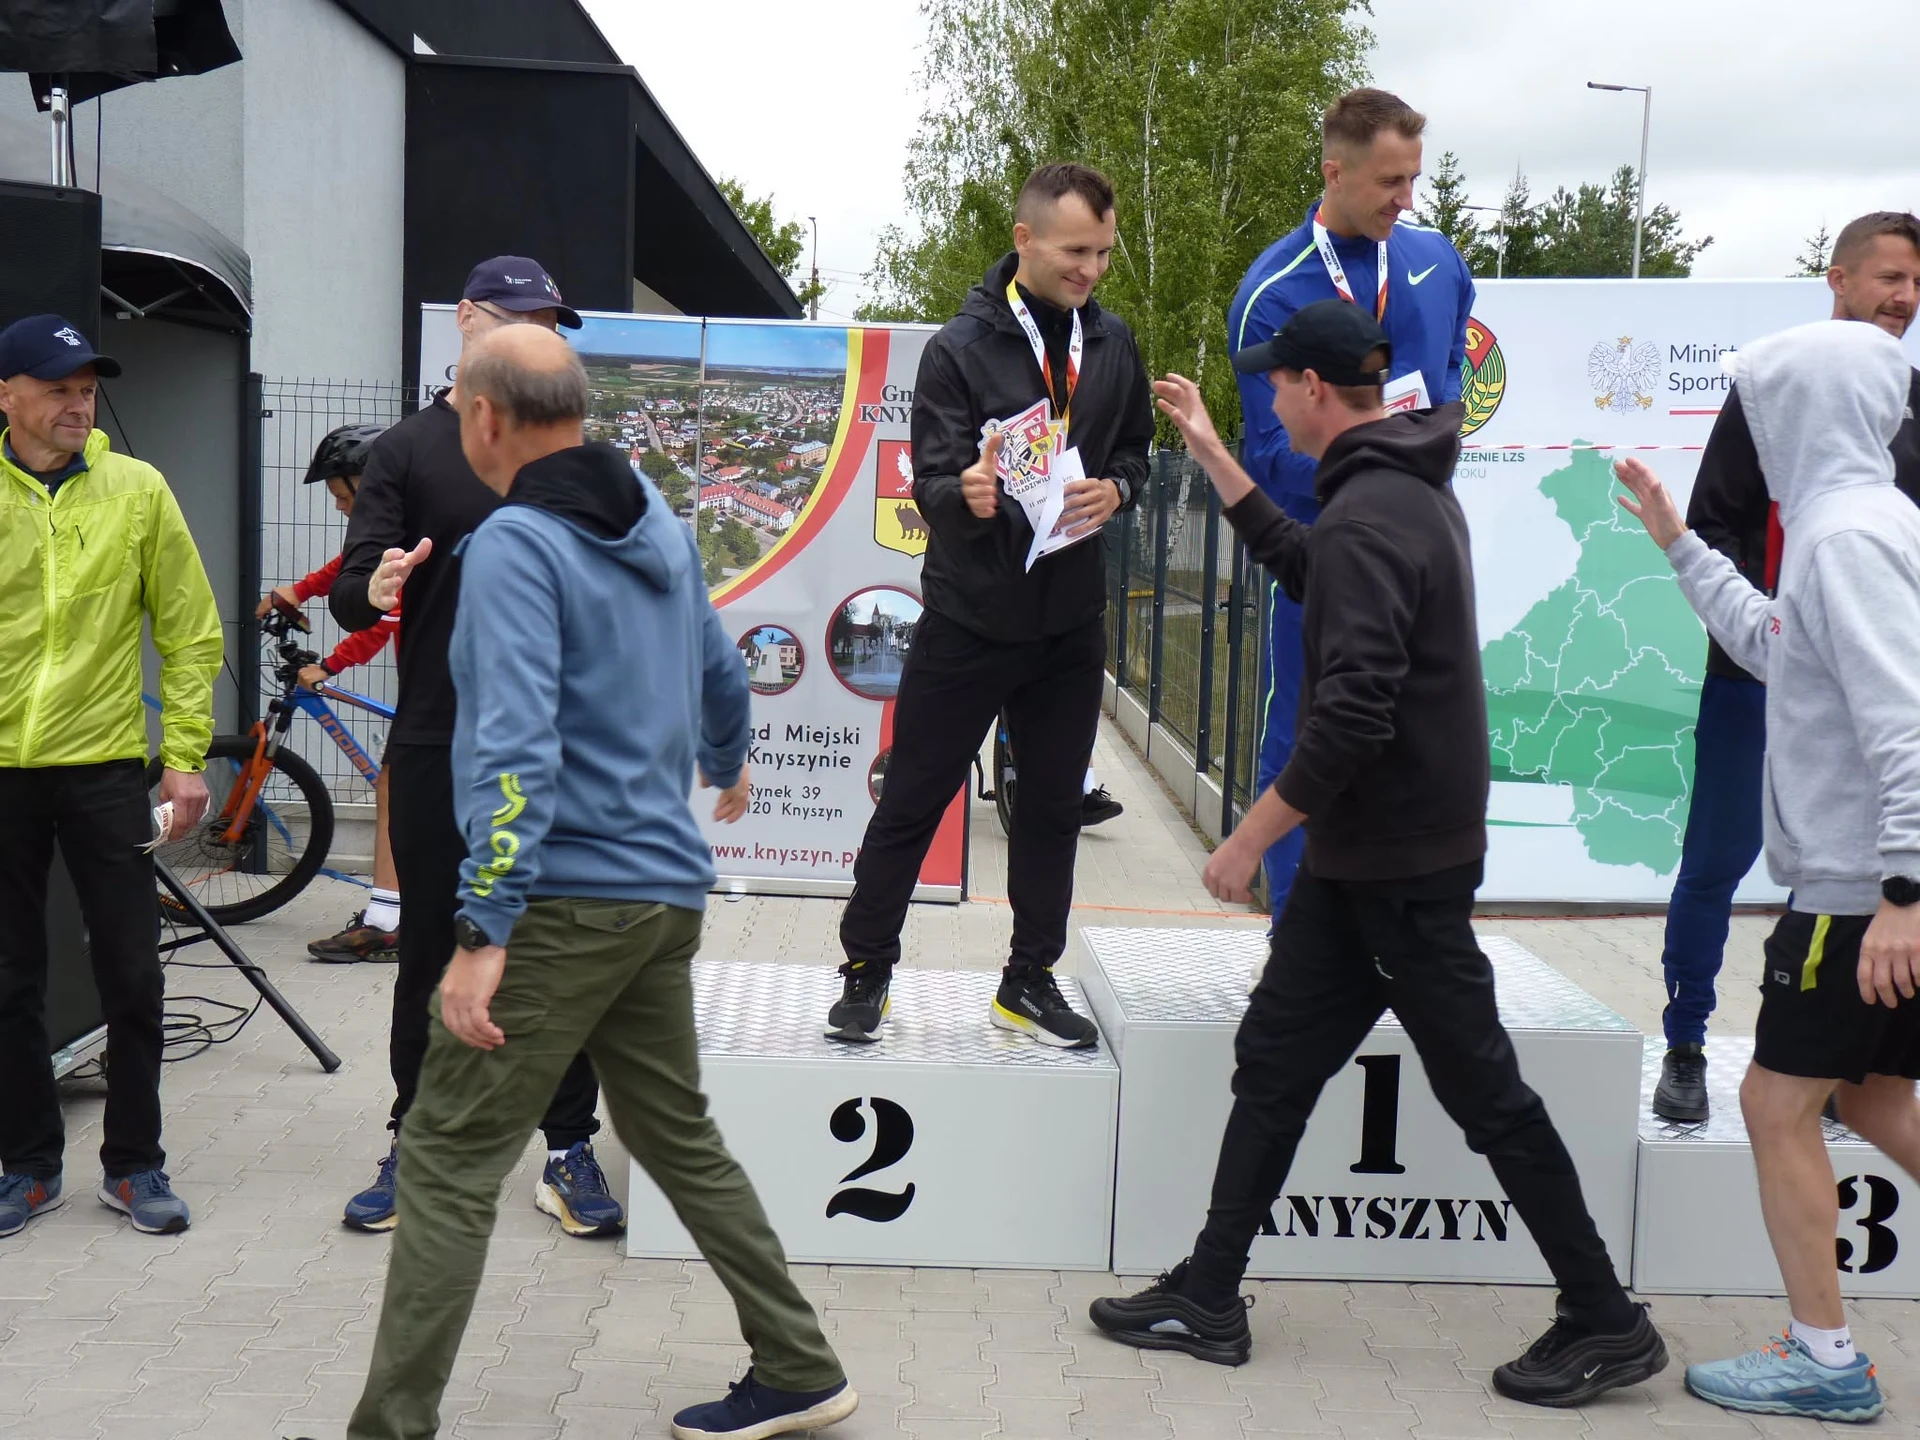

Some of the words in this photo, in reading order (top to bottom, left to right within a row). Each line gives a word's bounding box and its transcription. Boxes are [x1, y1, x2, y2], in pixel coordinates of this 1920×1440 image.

[1503, 452, 1525, 463] LZS
[786, 724, 860, 748] Miejski
[747, 746, 851, 772] Knyszynie
[802, 785, 821, 800] 39
[782, 802, 843, 821] Knyszyn
[1020, 996, 1043, 1018] BROOKS
[1350, 1054, 1406, 1174] 1
[826, 1096, 916, 1223] 2
[1834, 1174, 1899, 1274] 3
